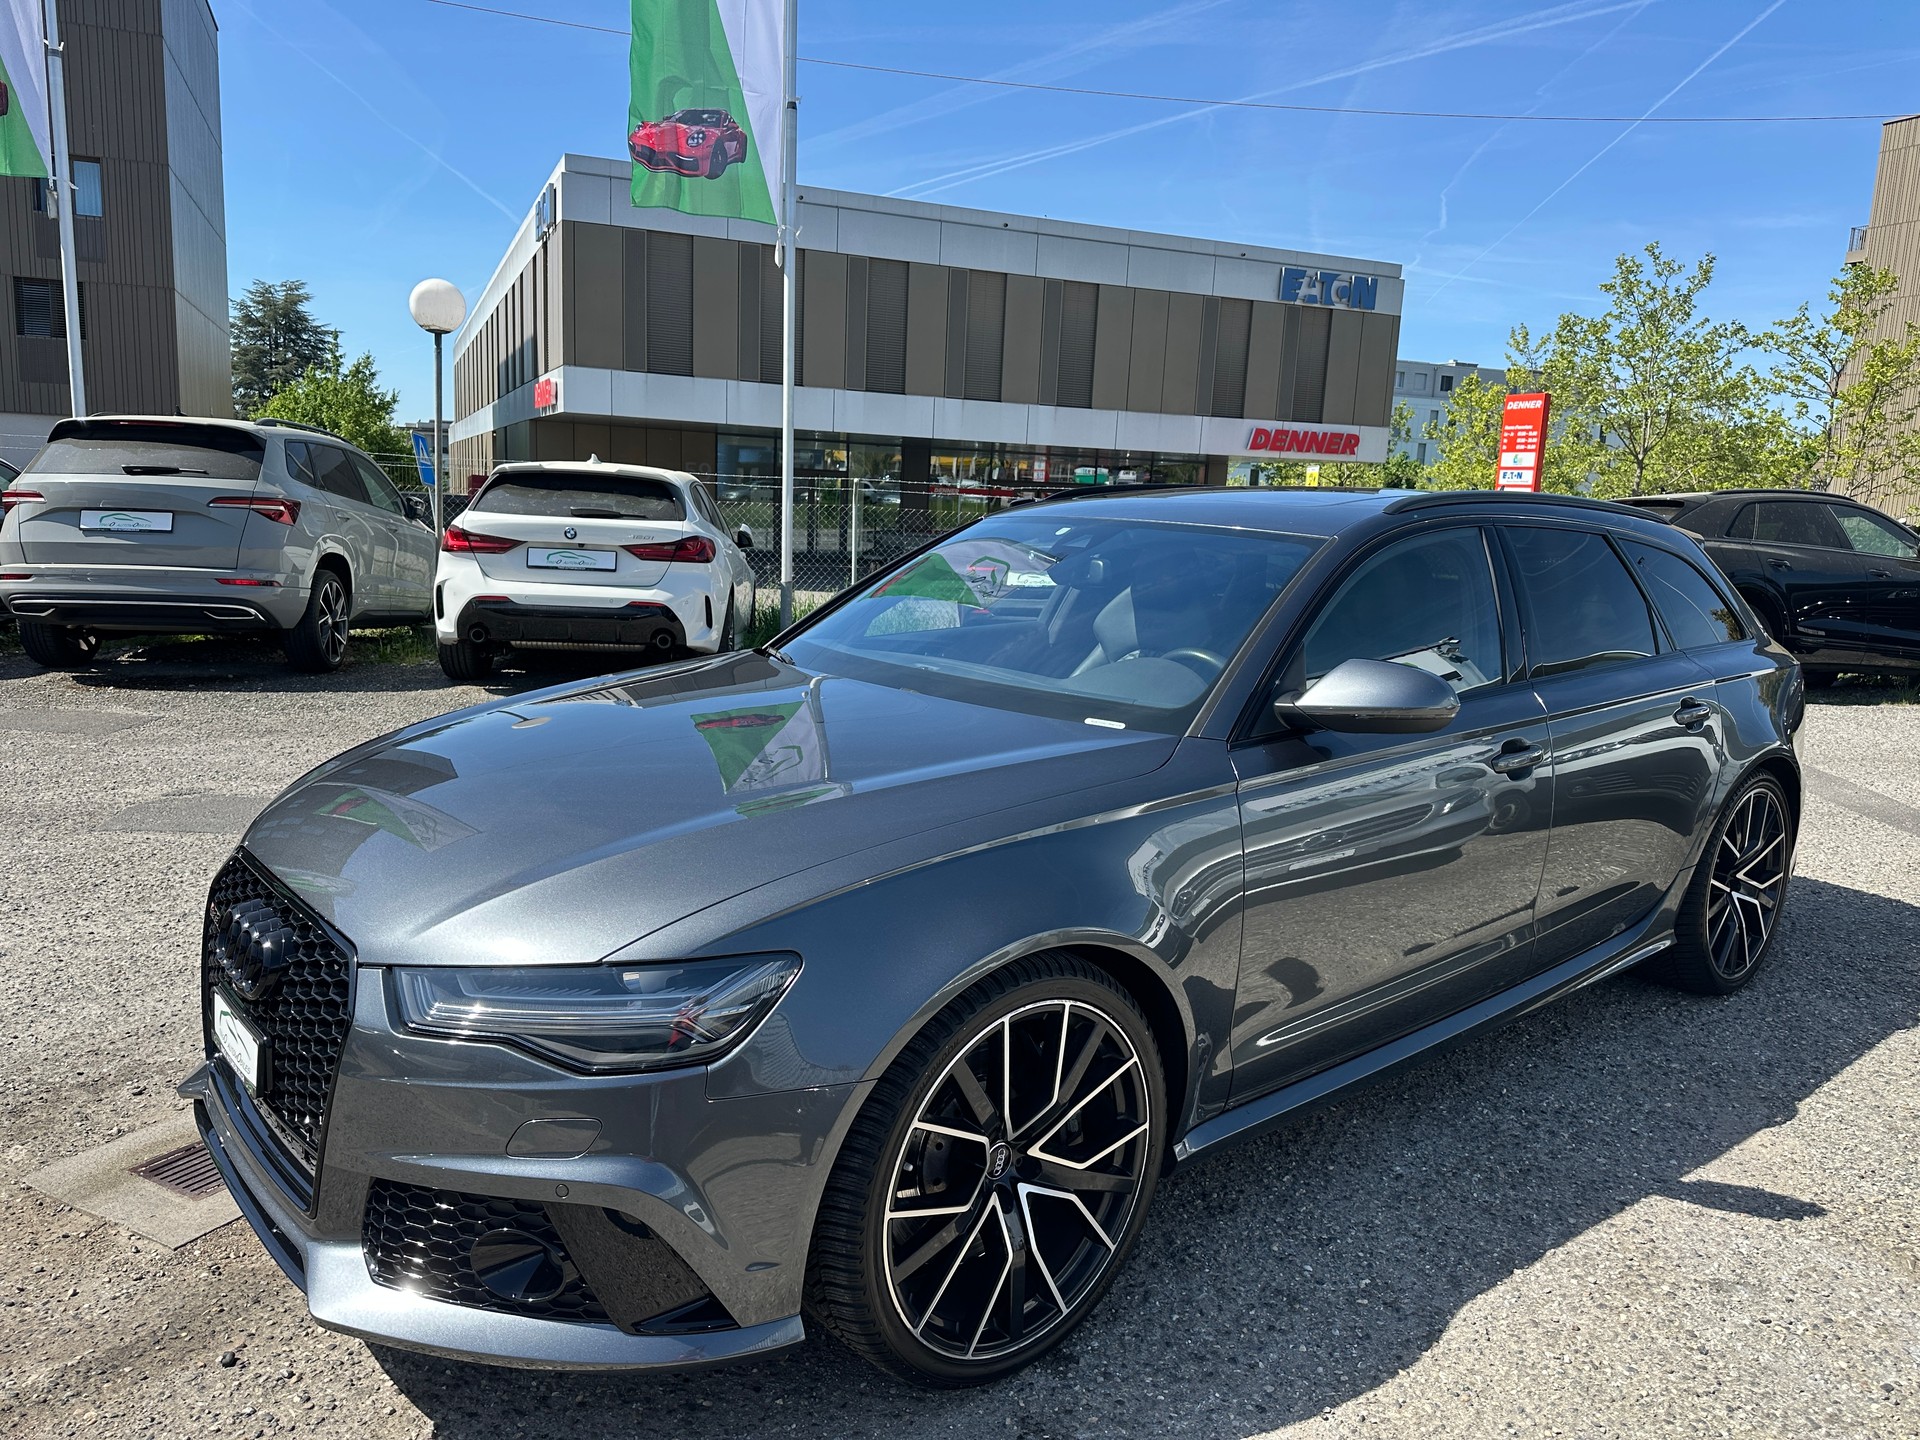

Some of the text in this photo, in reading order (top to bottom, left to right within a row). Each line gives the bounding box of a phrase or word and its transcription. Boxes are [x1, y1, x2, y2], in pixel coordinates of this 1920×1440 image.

[1280, 267, 1378, 310] EATON
[1507, 401, 1542, 410] DENNER
[1247, 427, 1360, 455] DENNER
